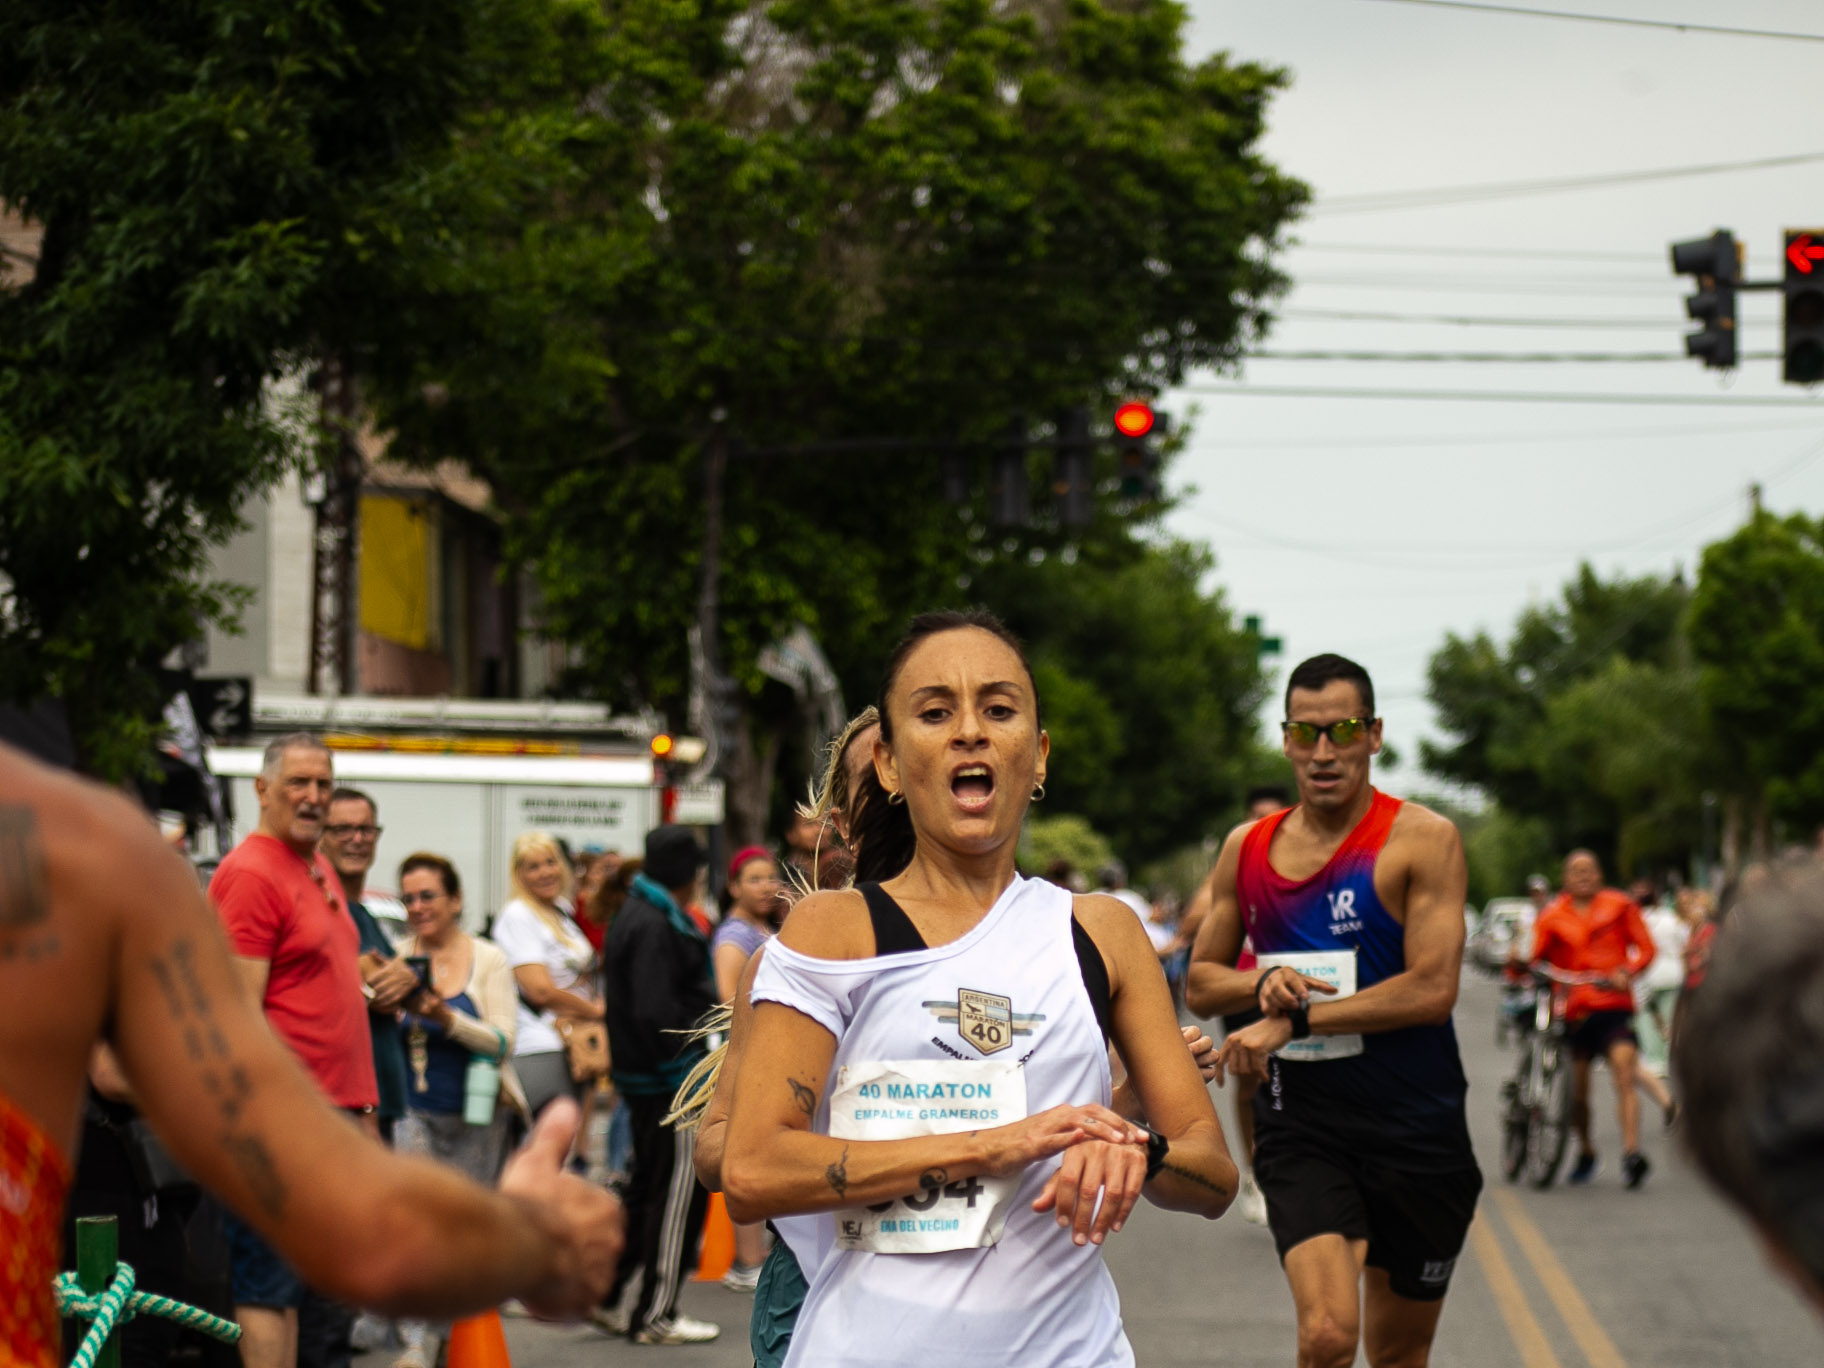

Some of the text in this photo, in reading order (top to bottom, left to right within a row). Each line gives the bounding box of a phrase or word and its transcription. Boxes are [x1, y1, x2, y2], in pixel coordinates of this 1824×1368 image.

[965, 995, 1004, 1007] ARGENTINA
[971, 1023, 1001, 1045] 40
[859, 1083, 992, 1099] 40 MARATON
[855, 1109, 999, 1121] EMPALME GRANEROS
[899, 1220, 916, 1233] DEL
[919, 1219, 959, 1233] VECINO
